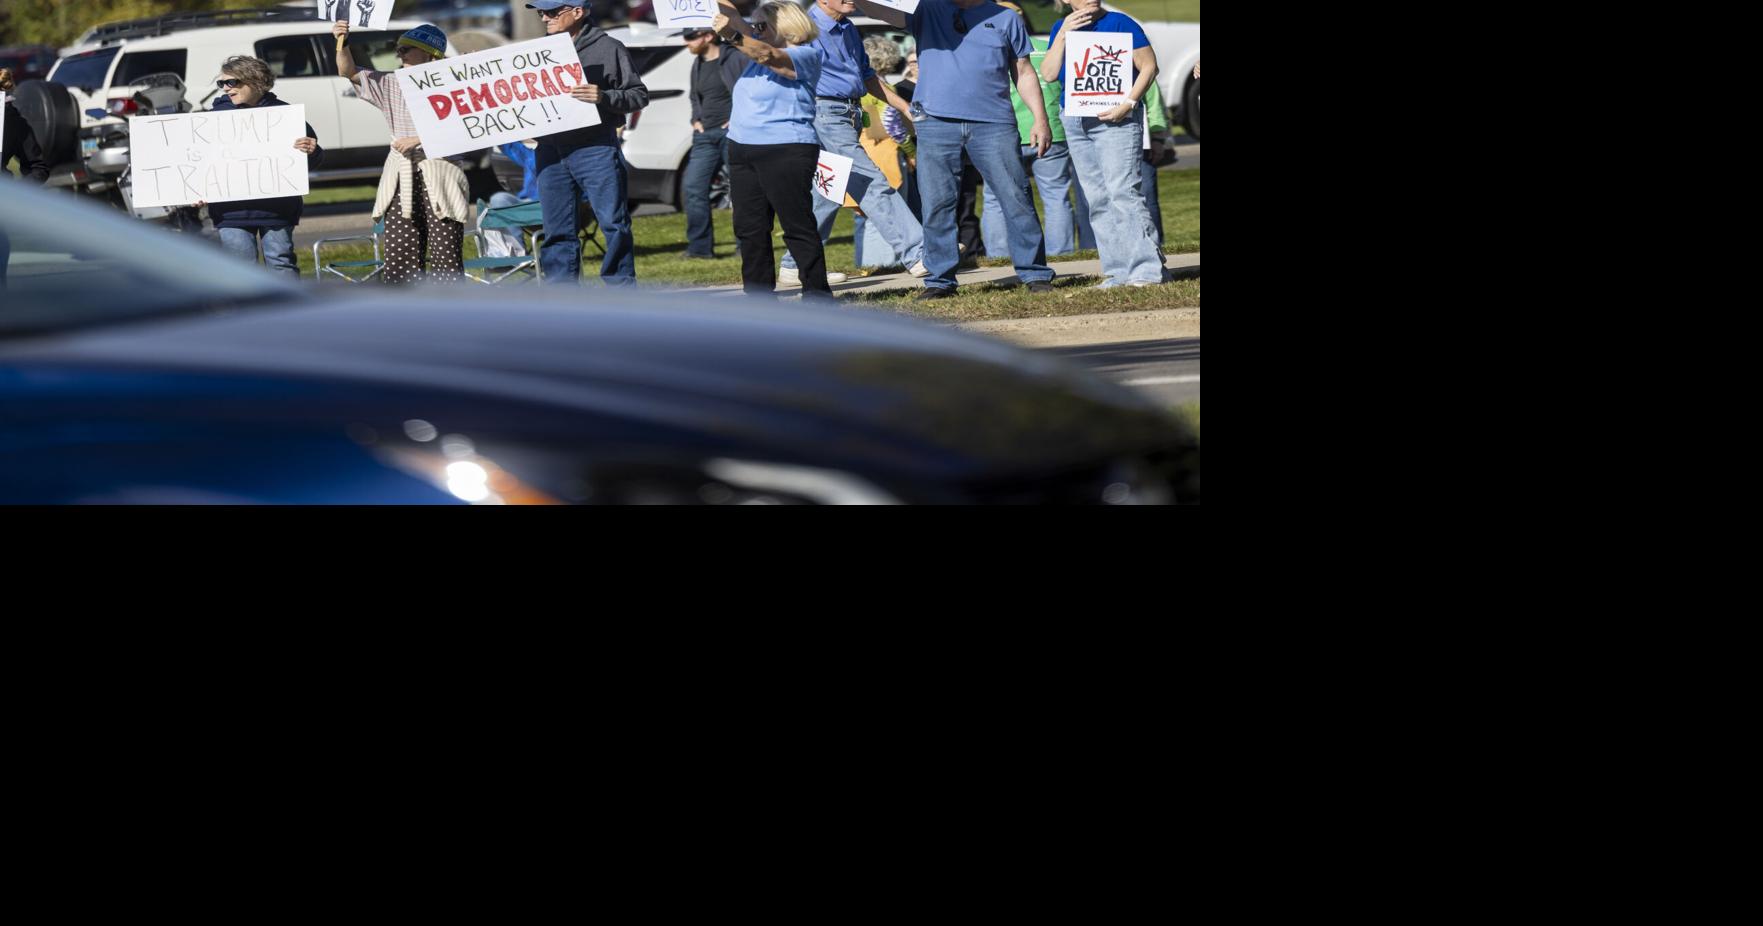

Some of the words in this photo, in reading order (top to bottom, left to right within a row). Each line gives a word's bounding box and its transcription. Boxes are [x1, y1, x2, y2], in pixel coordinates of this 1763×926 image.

[409, 70, 444, 90] WE
[449, 58, 503, 82] WANT
[512, 49, 559, 70] OUR
[1073, 47, 1122, 78] VOTE
[427, 62, 583, 120] DEMOCRACY
[1073, 77, 1122, 94] EARLY
[147, 111, 283, 146] TRUMP
[462, 105, 536, 139] BACK
[186, 147, 202, 162] is
[142, 155, 299, 201] TRAITOR
